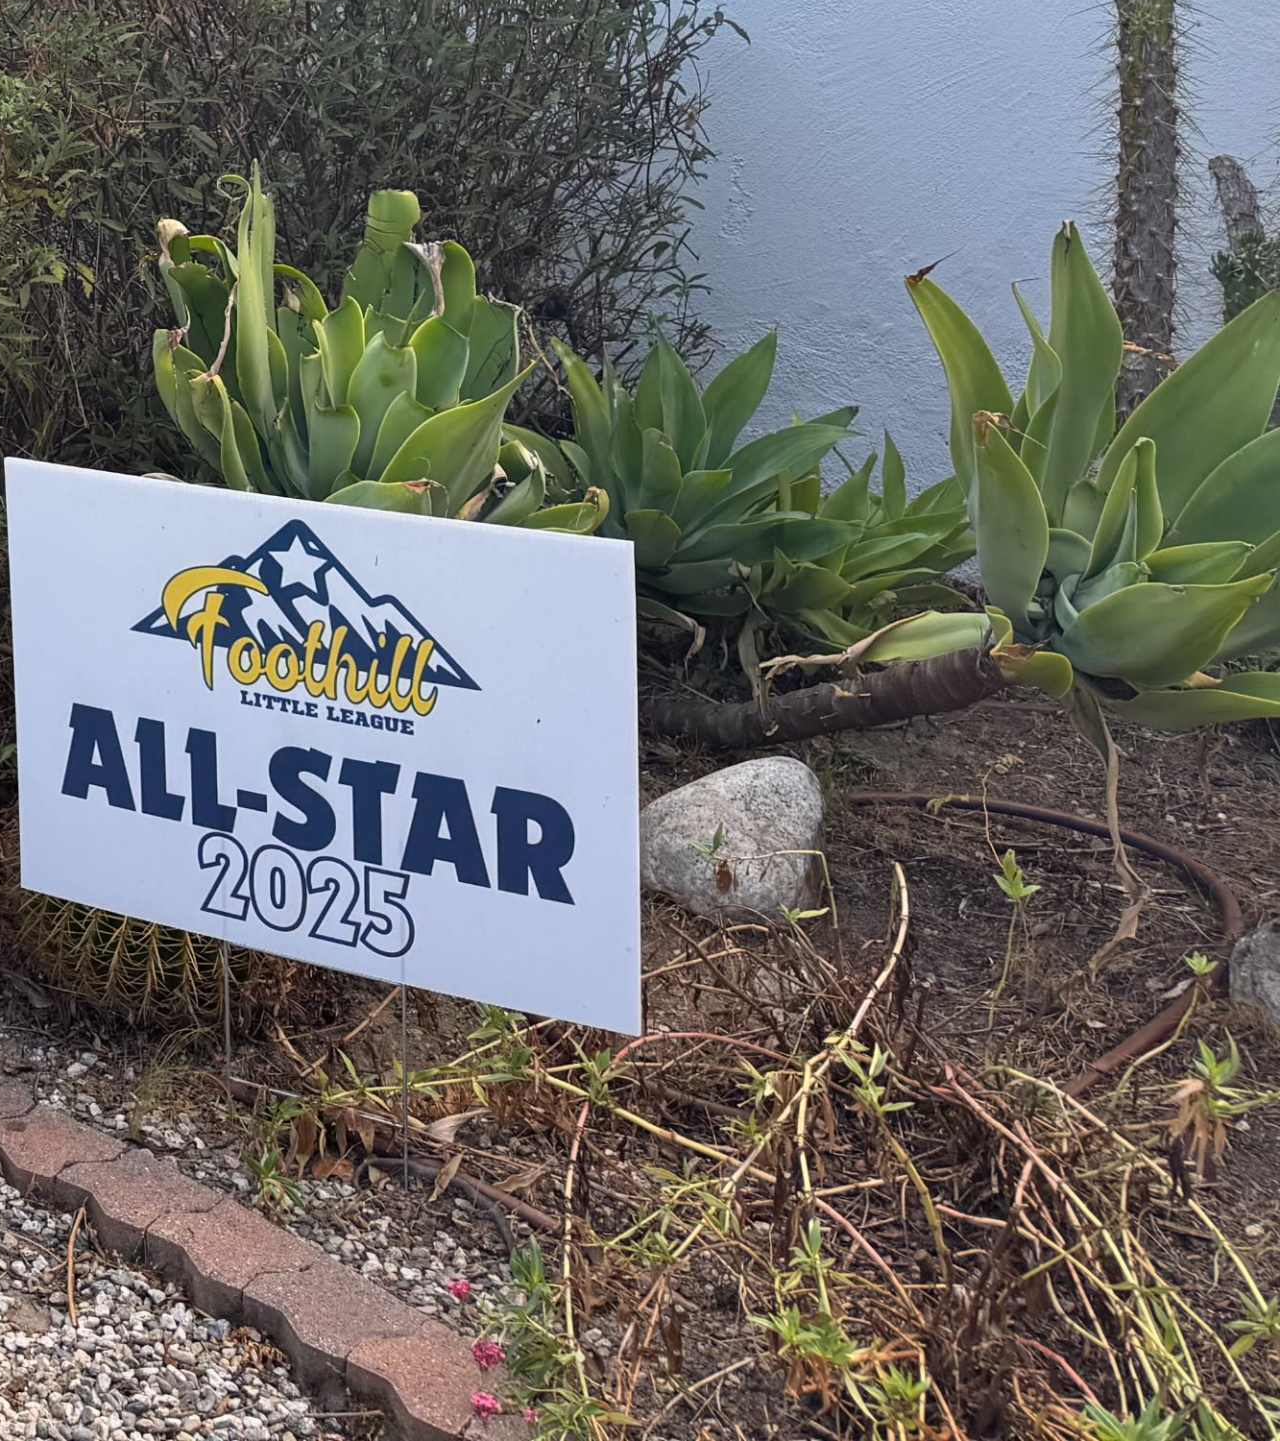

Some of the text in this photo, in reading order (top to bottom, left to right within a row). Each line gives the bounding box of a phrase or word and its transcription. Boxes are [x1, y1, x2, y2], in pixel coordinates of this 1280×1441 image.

[161, 565, 439, 717] Foothill
[240, 690, 415, 736] LITTLE LEAGUE
[61, 702, 576, 906] ALL-STAR
[197, 831, 416, 958] 2025
